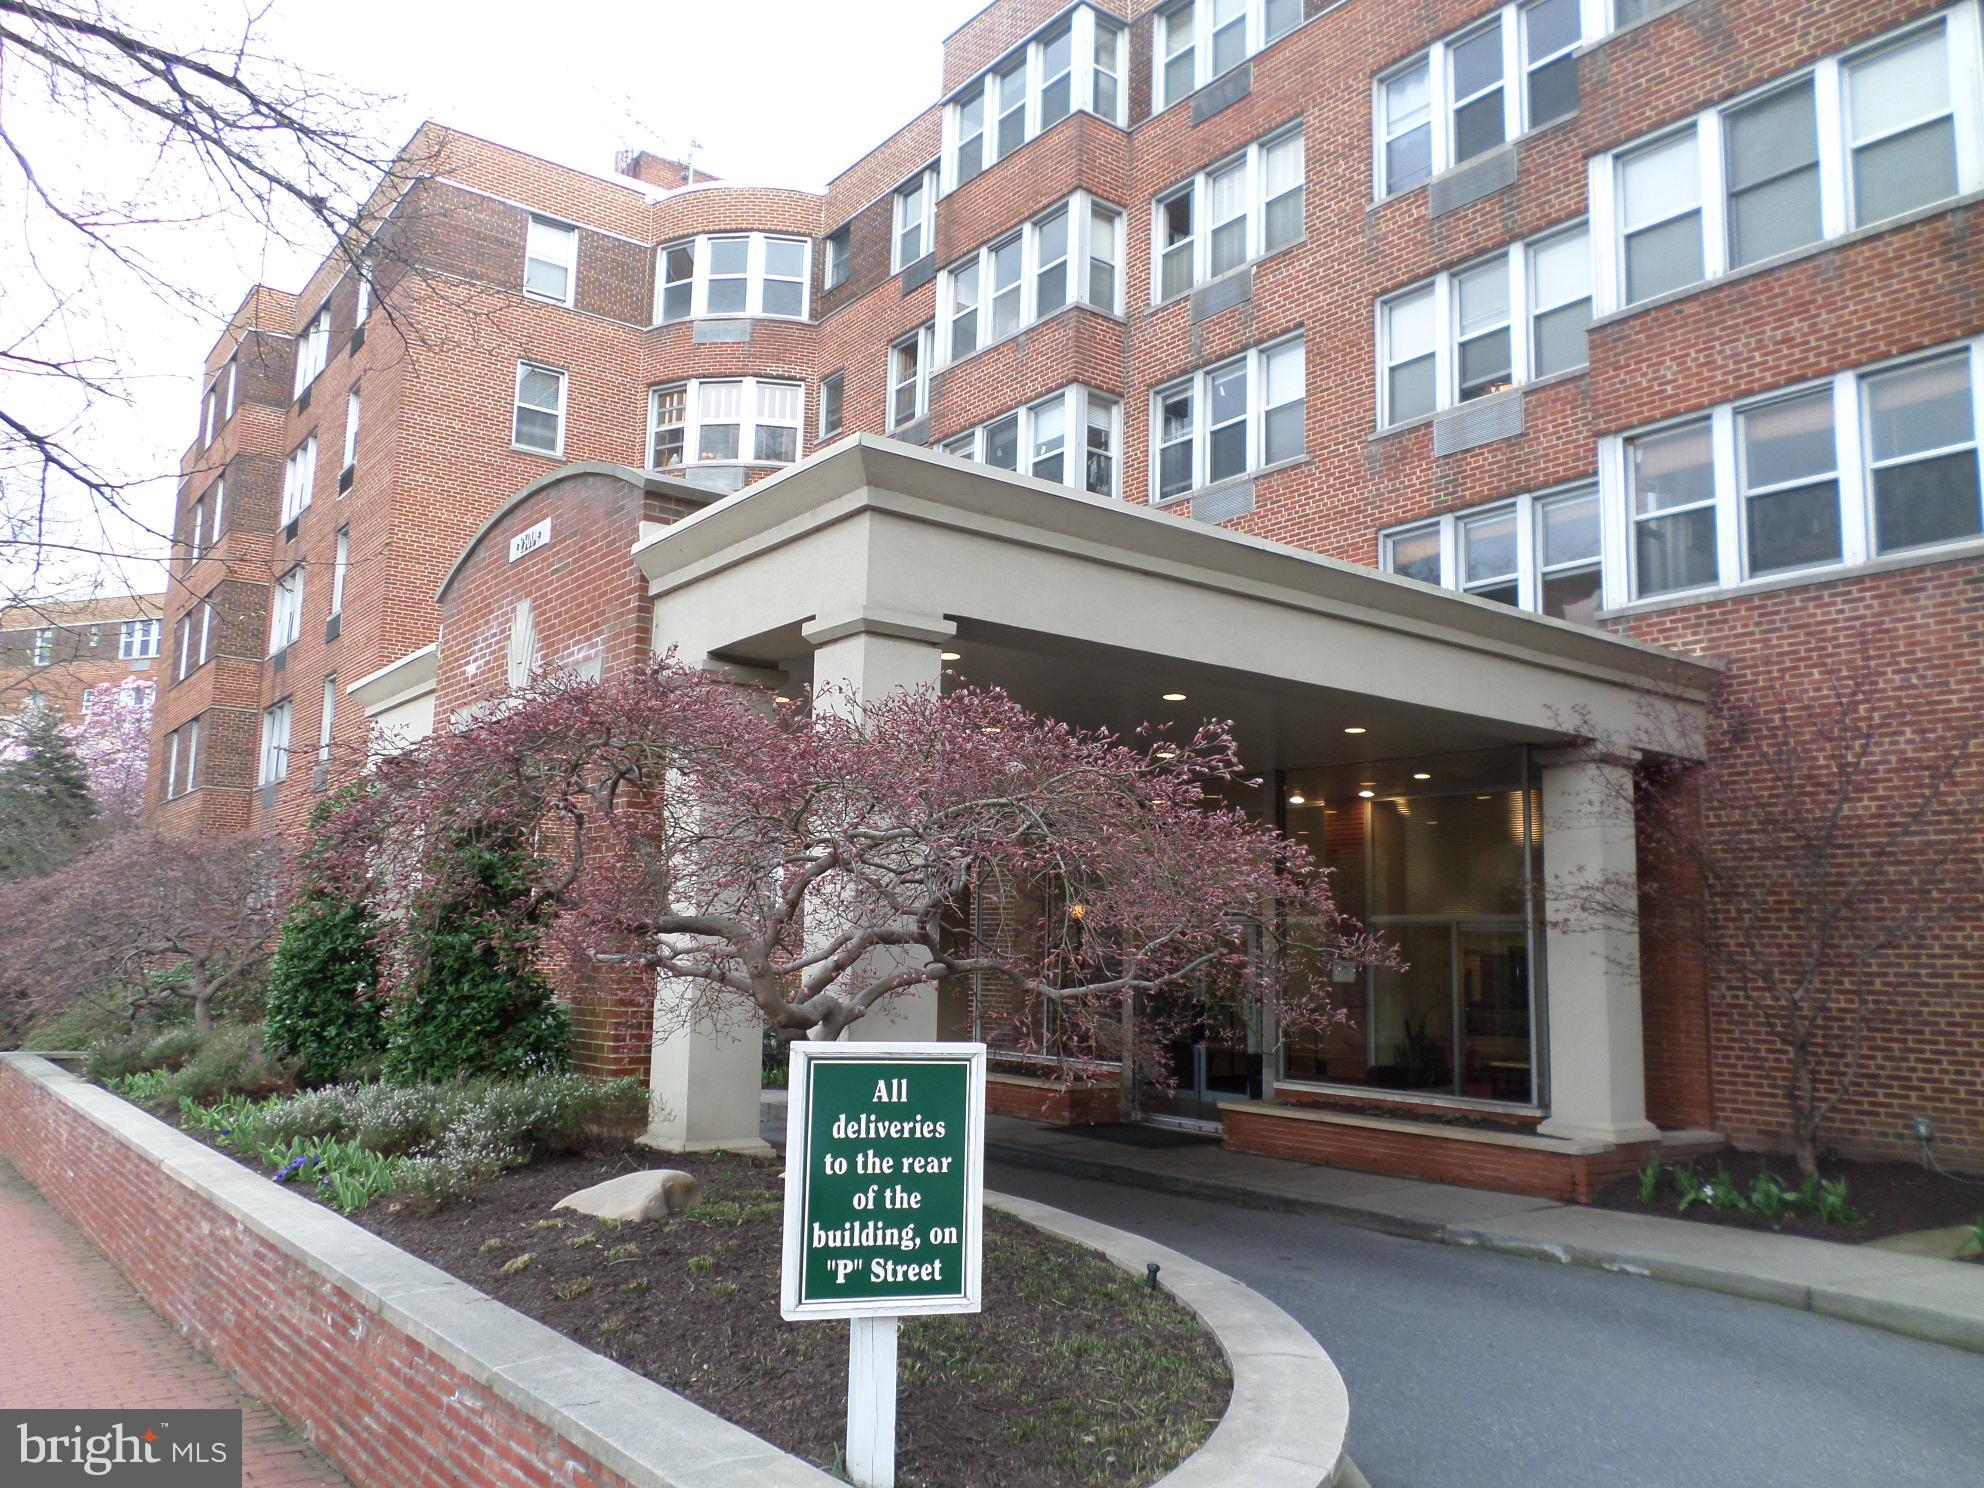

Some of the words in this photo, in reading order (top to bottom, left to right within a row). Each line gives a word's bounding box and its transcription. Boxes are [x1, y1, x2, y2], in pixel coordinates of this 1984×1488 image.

[872, 1079, 907, 1102] All
[832, 1114, 946, 1139] deliveries
[824, 1154, 847, 1174] to
[856, 1150, 894, 1173] the
[902, 1157, 952, 1173] rear
[852, 1185, 878, 1209] of
[884, 1185, 921, 1208] the
[812, 1221, 921, 1250] building,
[930, 1226, 957, 1244] on
[827, 1259, 863, 1284] "P"
[870, 1258, 942, 1283] Street
